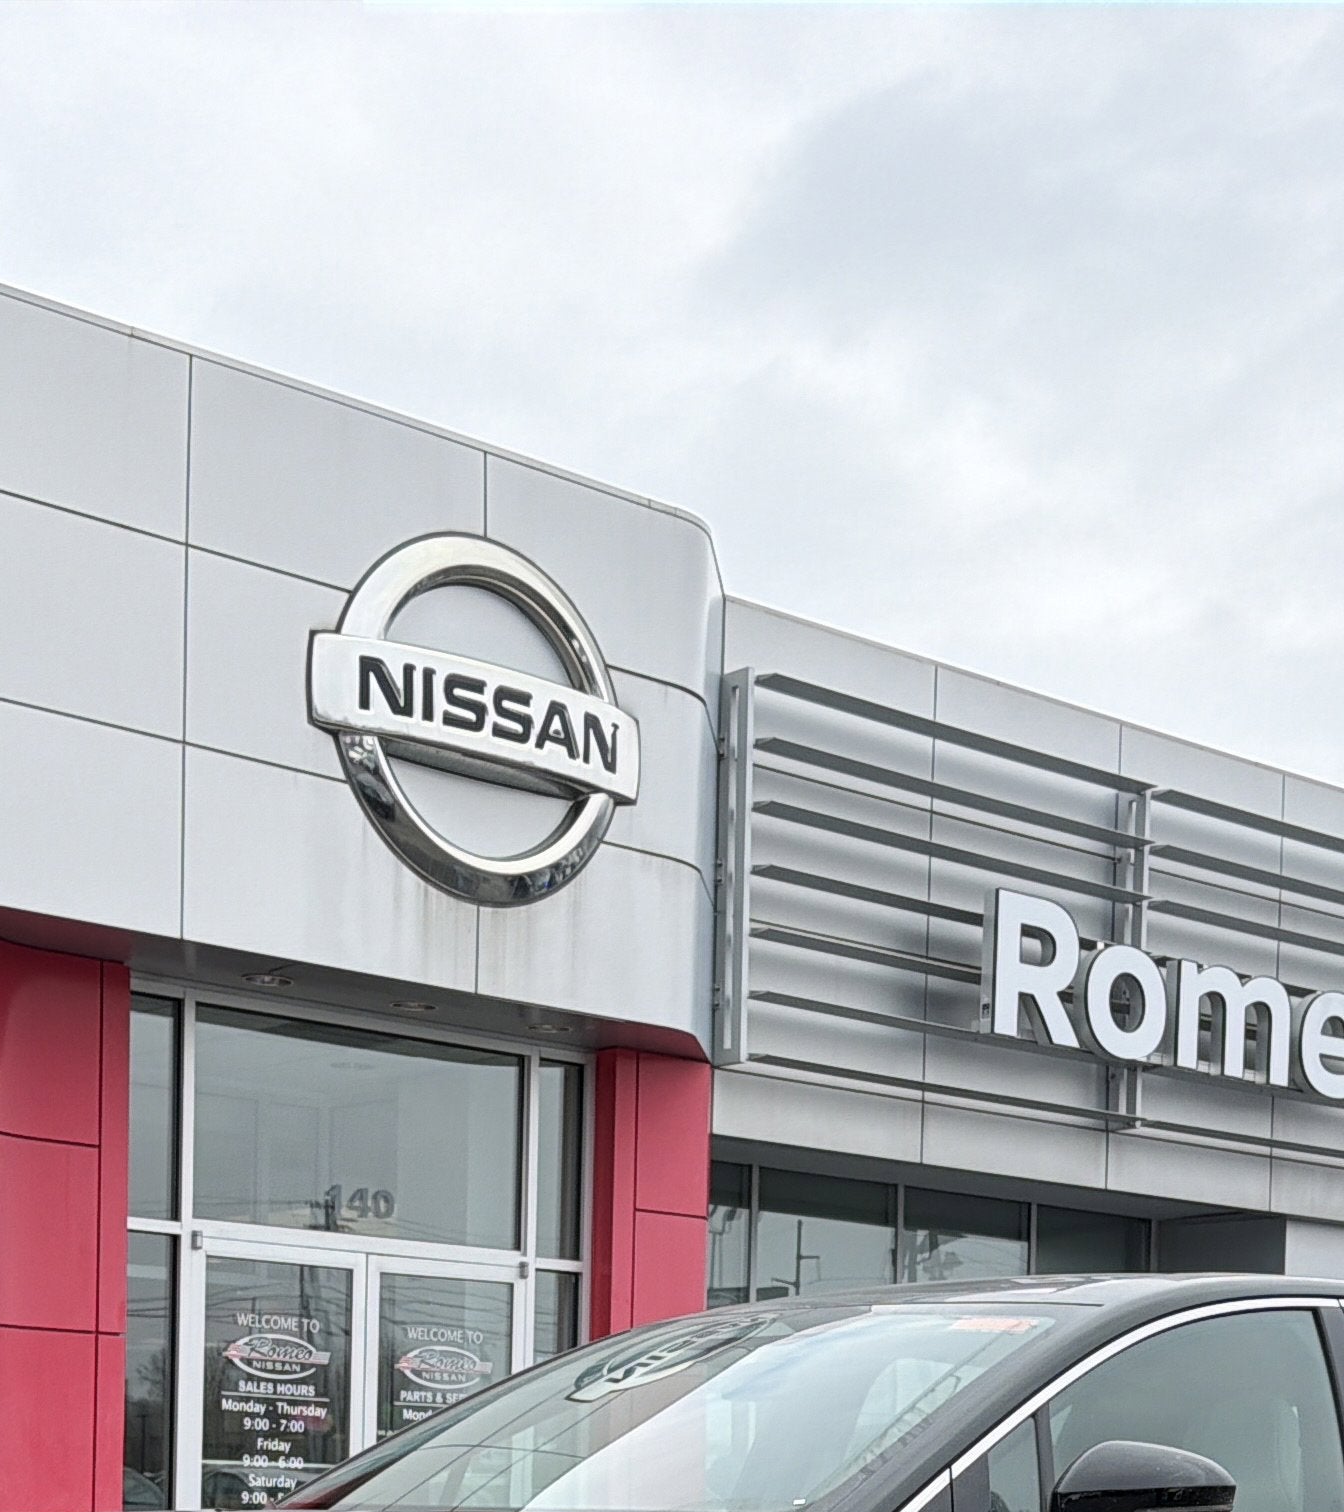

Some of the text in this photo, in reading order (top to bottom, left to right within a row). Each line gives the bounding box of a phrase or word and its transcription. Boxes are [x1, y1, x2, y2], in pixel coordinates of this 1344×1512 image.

[358, 655, 620, 775] NISSAN
[324, 1184, 395, 1219] 140
[236, 1312, 320, 1334] WELCOME TO
[406, 1326, 484, 1344] WELCOME TO
[244, 1336, 314, 1361] Romeo
[252, 1360, 301, 1372] NISSAN
[421, 1371, 466, 1382] NISSAN
[238, 1380, 316, 1397] SALES HOURS
[399, 1390, 433, 1402] PARTS
[221, 1398, 267, 1415] Monday
[276, 1401, 327, 1419] Thursday
[243, 1417, 269, 1431] 9:00
[279, 1419, 305, 1433] 7:00
[257, 1437, 292, 1453] Friday
[242, 1454, 268, 1468] 9:00
[248, 1473, 297, 1490] Saturday
[241, 1490, 267, 1504] 9:00
